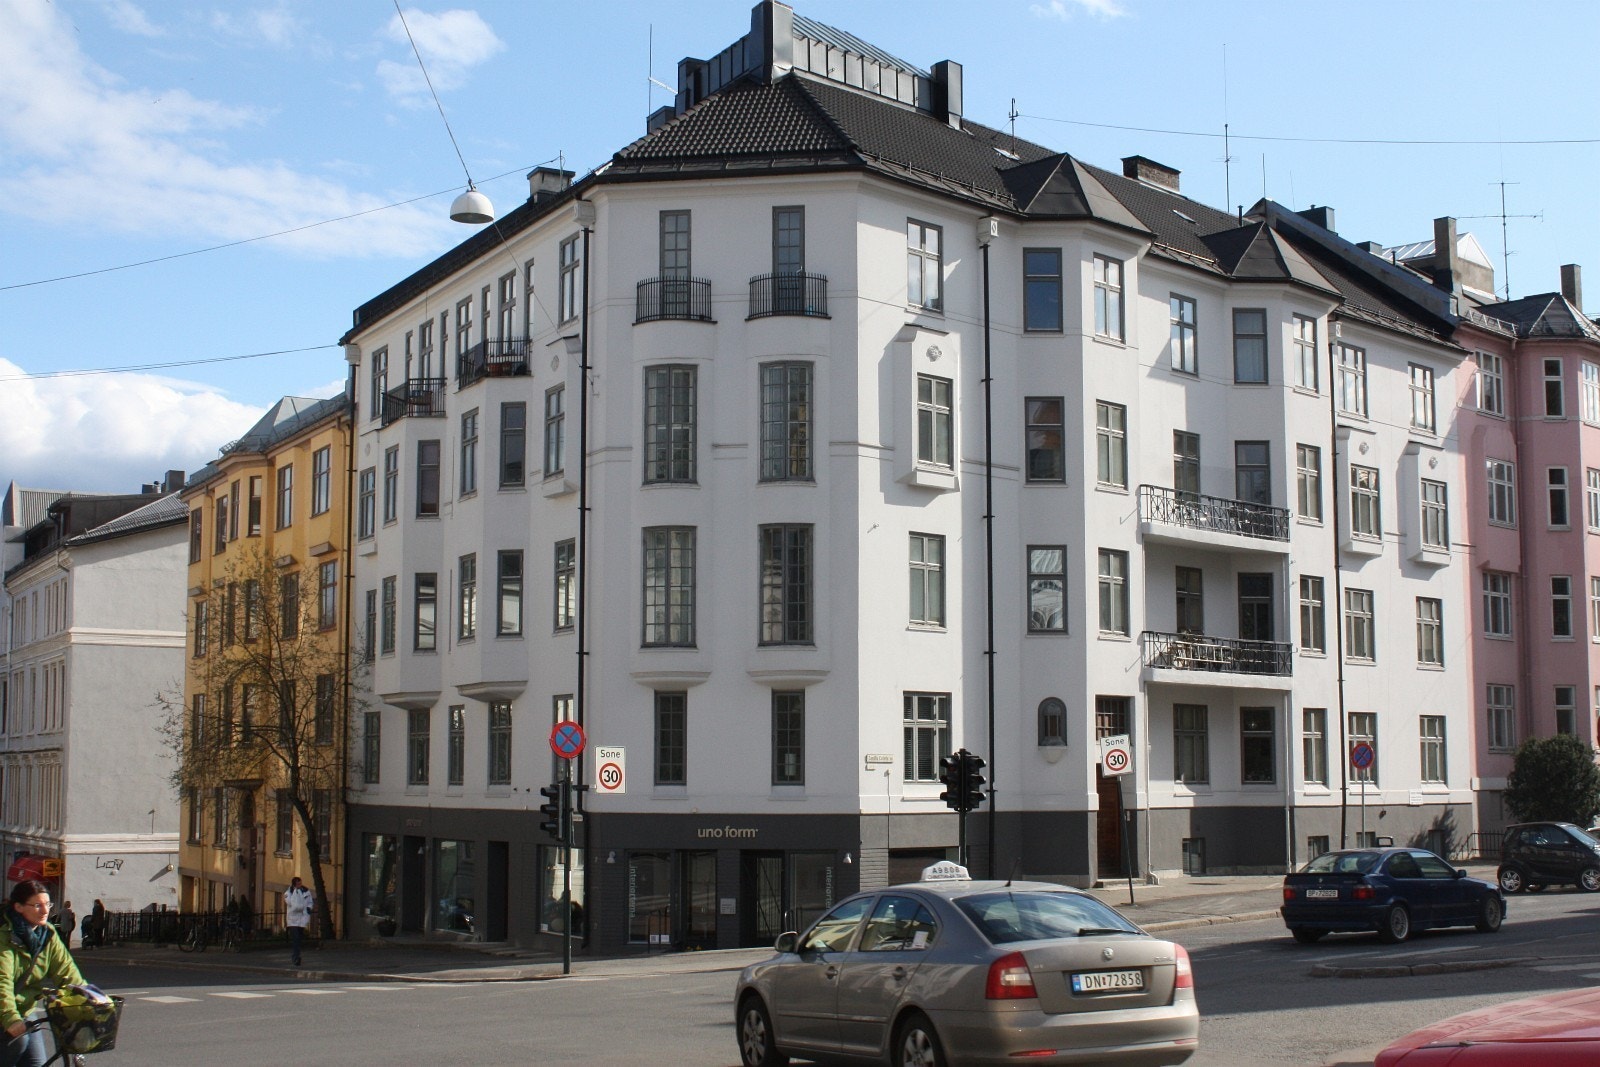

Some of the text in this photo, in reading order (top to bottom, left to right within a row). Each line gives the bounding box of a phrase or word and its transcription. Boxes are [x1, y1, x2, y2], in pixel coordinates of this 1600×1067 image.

[600, 749, 621, 758] Sone
[1110, 754, 1125, 766] 30
[603, 769, 619, 783] 30
[697, 828, 723, 838] uno
[1085, 973, 1142, 988] DN 72858
